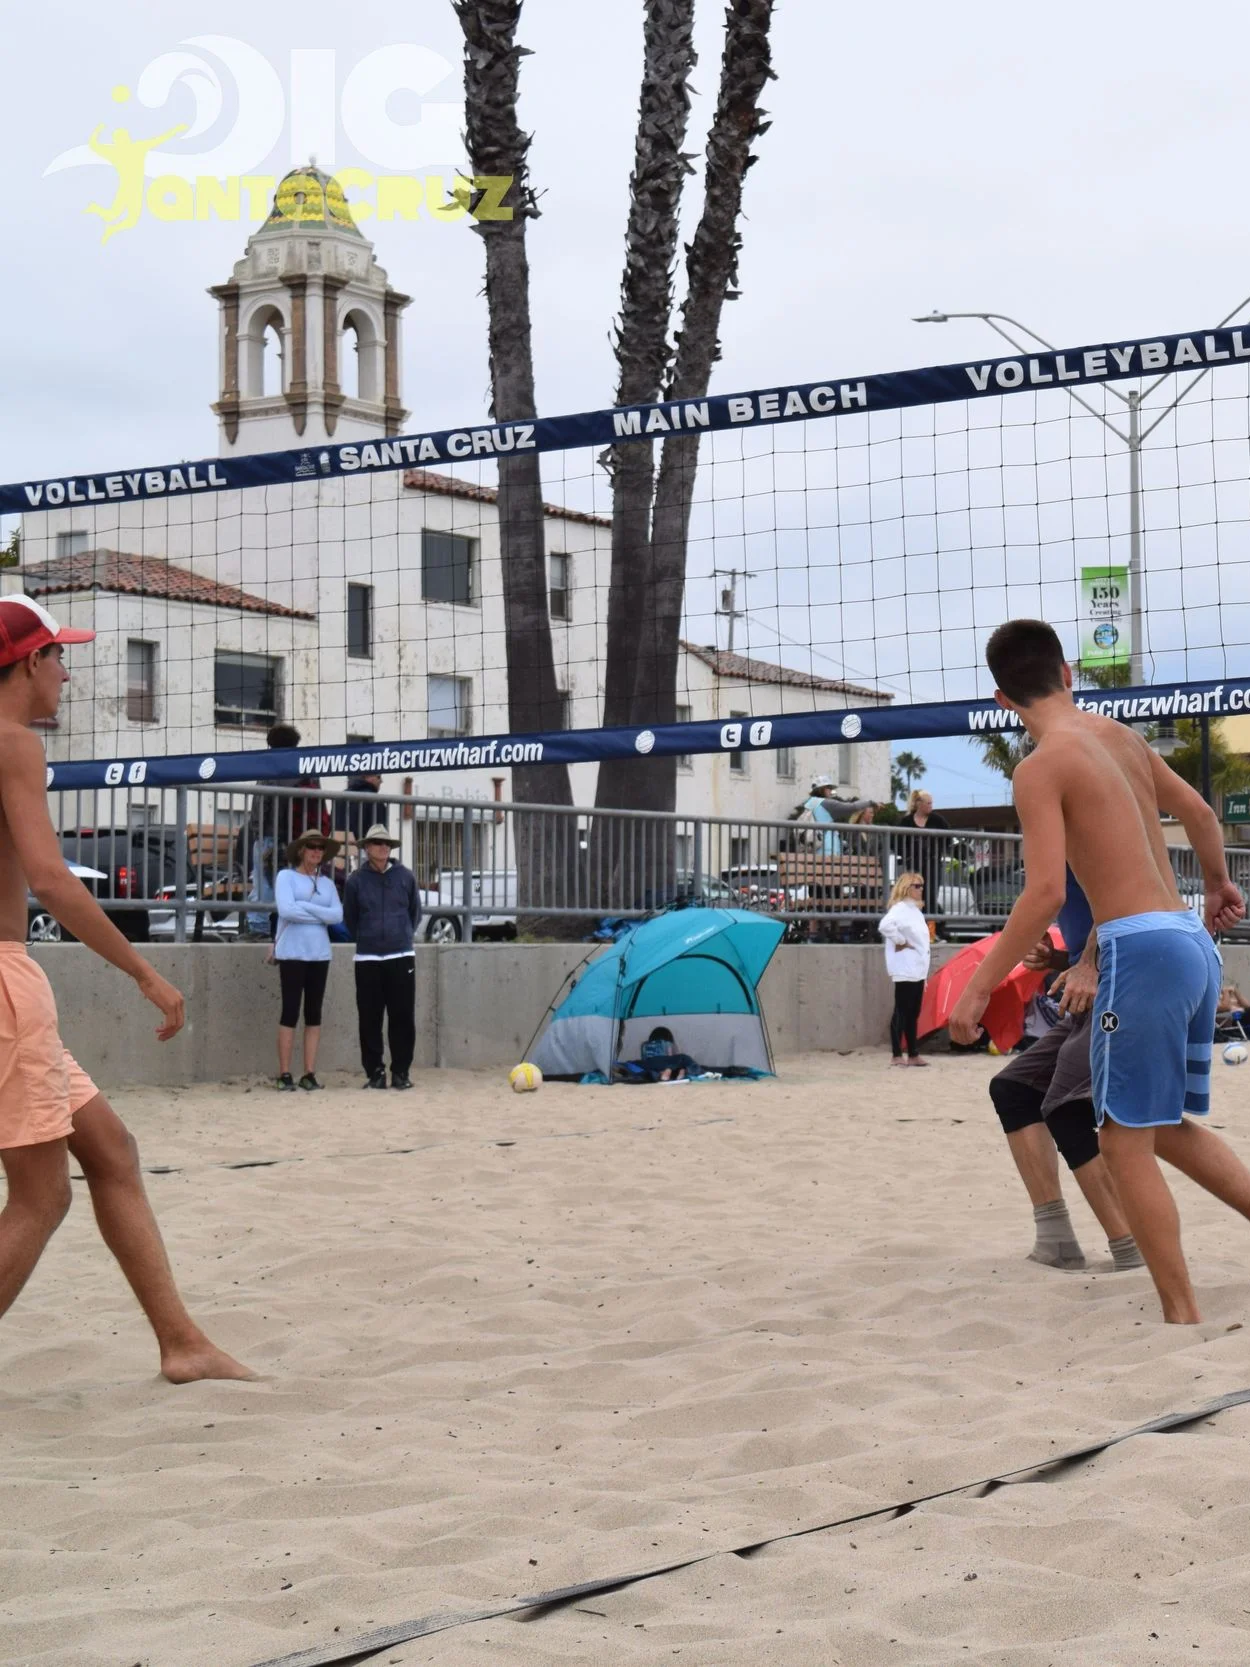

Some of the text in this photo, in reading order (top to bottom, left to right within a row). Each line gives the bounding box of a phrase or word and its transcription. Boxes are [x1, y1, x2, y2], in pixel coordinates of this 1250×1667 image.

[612, 382, 868, 437] MAIN BEACH
[338, 438, 441, 471] SANTA
[446, 424, 537, 457] CRUZ
[24, 464, 228, 507] VOLLEYBALL
[1092, 586, 1120, 600] 150
[298, 740, 544, 774] www.santacruzwharf.com
[1227, 801, 1247, 815] Inn
